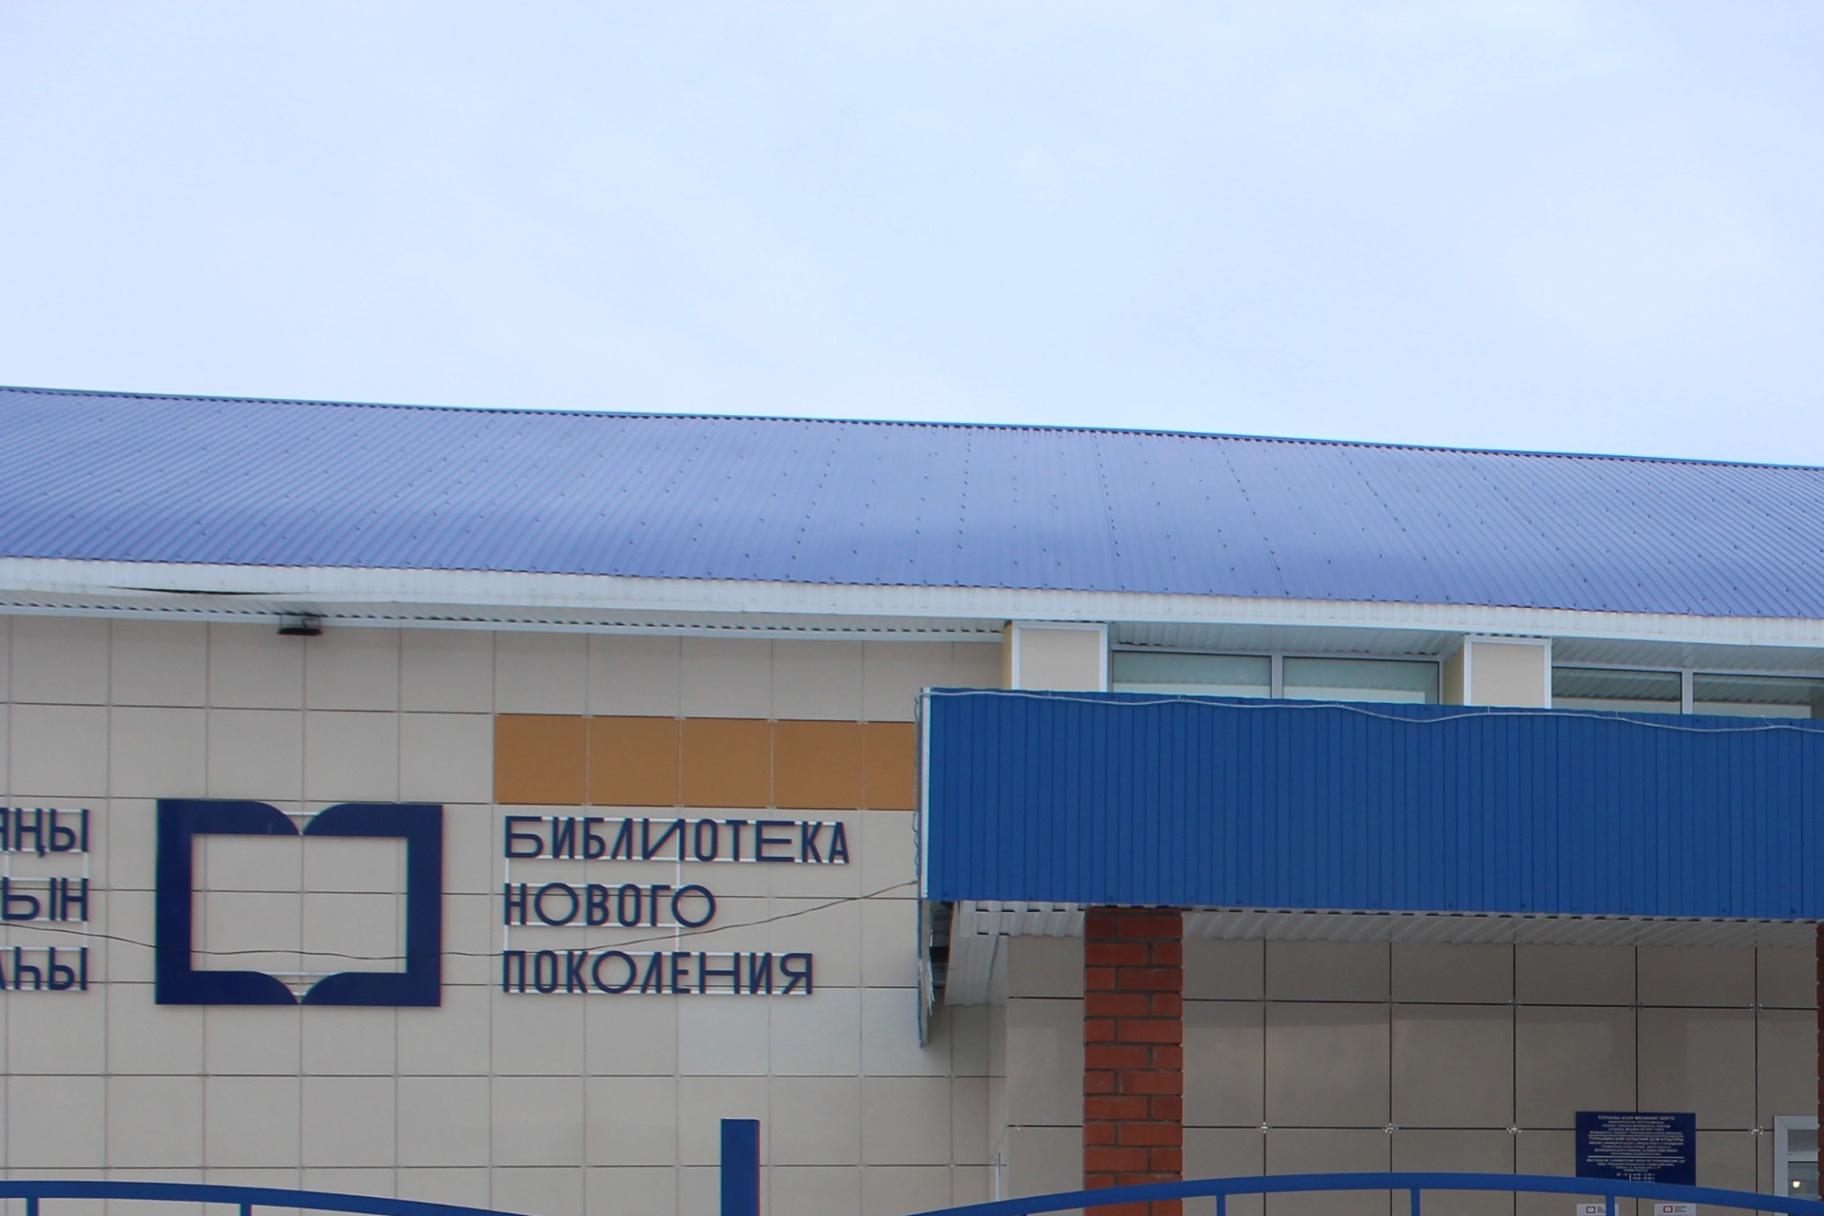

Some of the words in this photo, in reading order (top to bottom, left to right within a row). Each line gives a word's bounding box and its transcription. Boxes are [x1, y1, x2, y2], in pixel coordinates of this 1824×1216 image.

[505, 815, 849, 864] БИБЛИОТЕКА
[504, 882, 716, 928] НОВОГО
[0, 946, 88, 991] ҺЫ
[503, 950, 813, 995] ПОКОЛЕНИЯ
